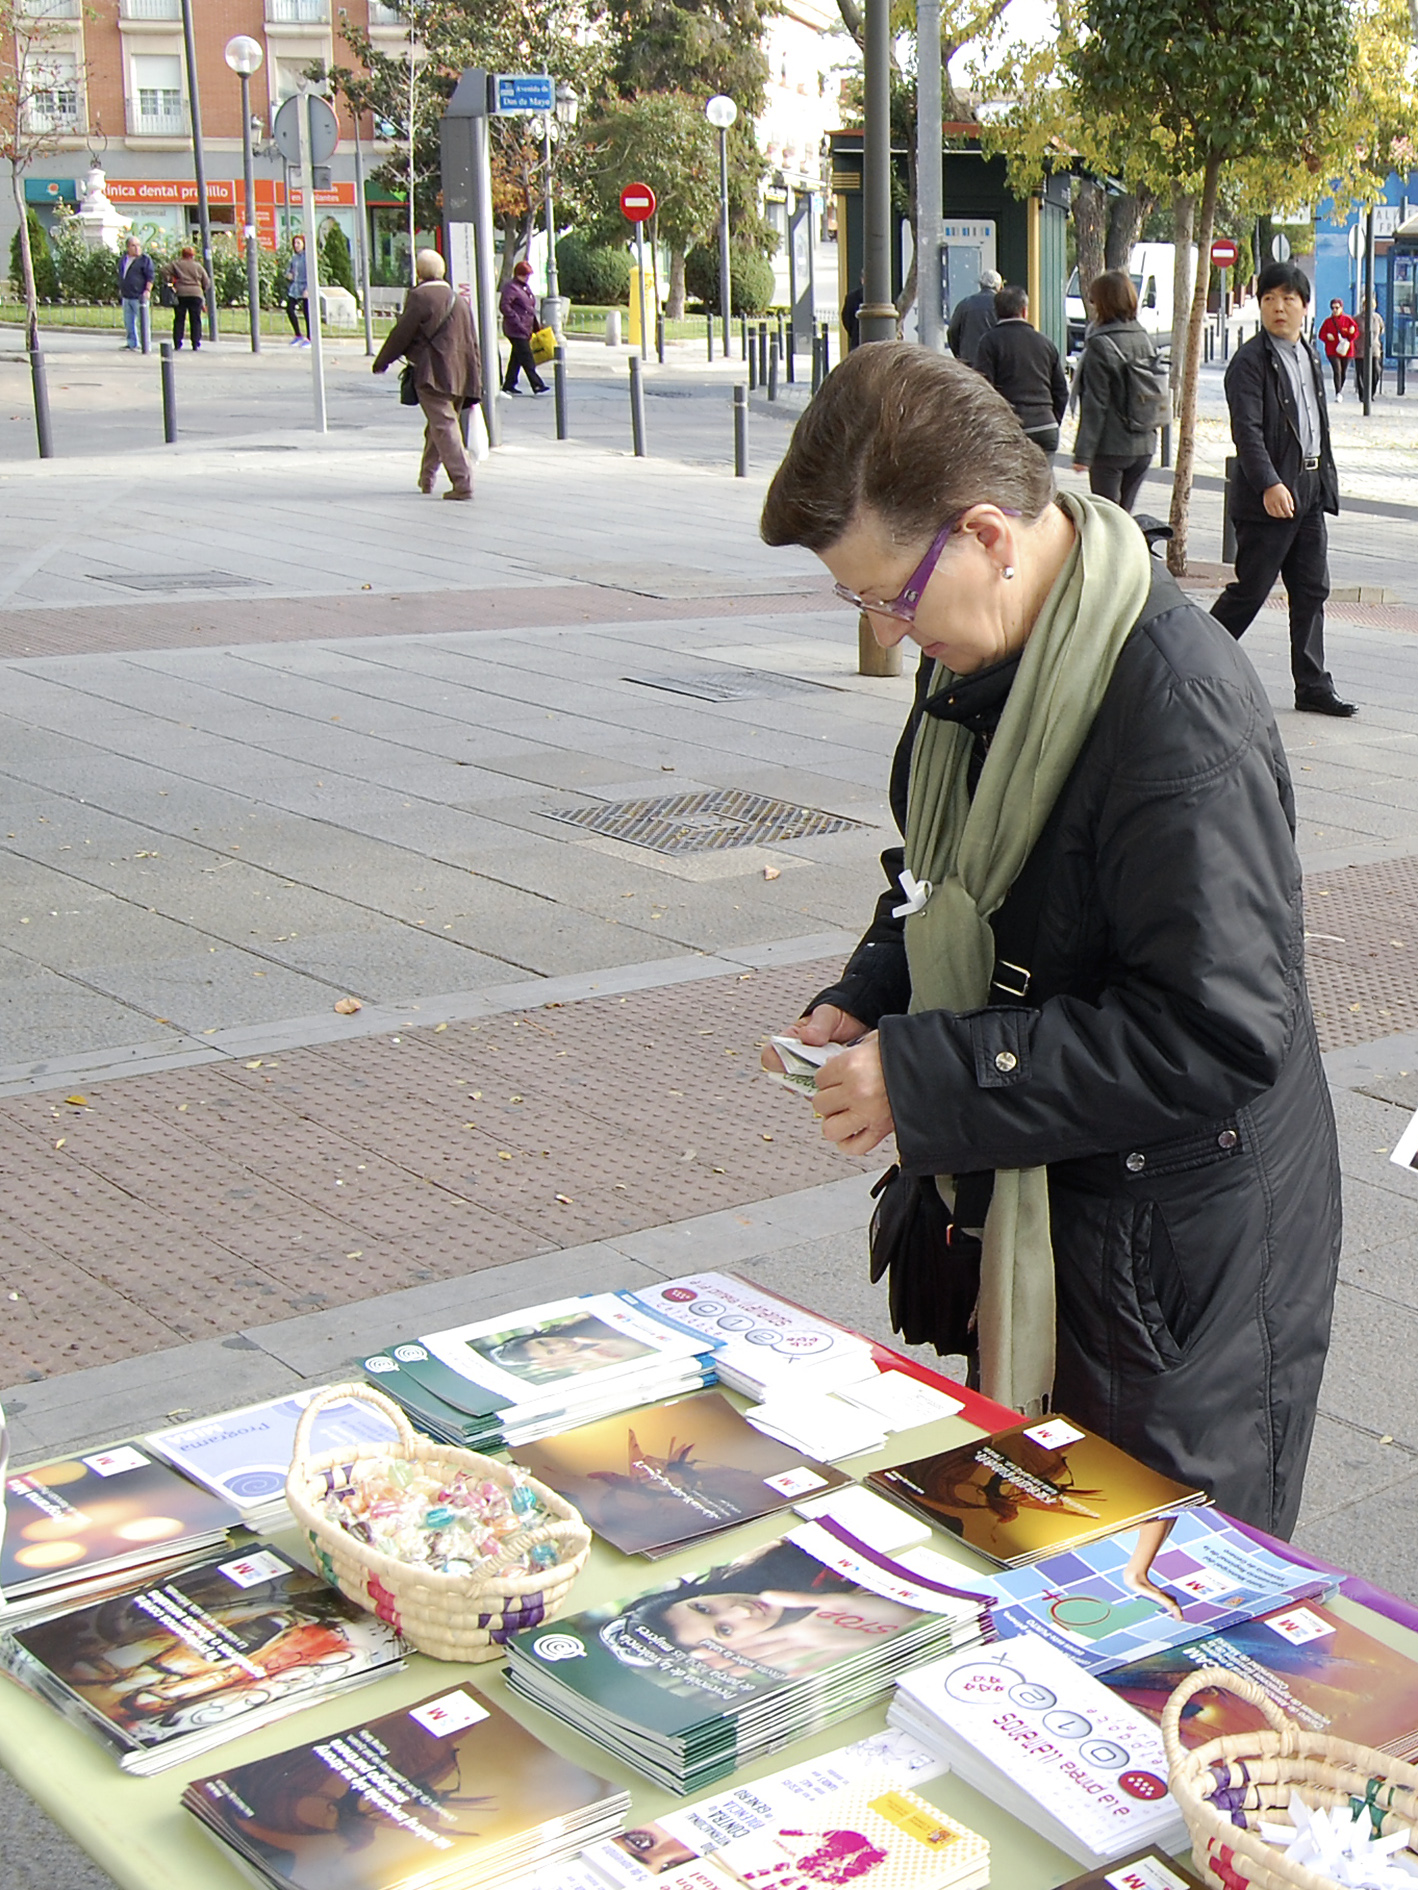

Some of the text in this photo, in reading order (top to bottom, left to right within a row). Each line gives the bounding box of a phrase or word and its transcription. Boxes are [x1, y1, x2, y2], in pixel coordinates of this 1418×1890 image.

[139, 183, 178, 197] dental
[164, 1423, 224, 1445] MIRA
[178, 1422, 268, 1451] Programa
[20, 1490, 71, 1523] Programa
[129, 1594, 168, 1617] contra
[142, 1588, 191, 1619] sexuales
[816, 1611, 899, 1634] STOP
[1025, 1618, 1052, 1638] PUNTO
[615, 1633, 664, 1665] violencia
[633, 1623, 675, 1652] mujeres
[699, 1636, 725, 1652] salud
[666, 1648, 687, 1662] las
[731, 1651, 757, 1667] sobre
[667, 1665, 686, 1677] de
[705, 1666, 742, 1687] pareja
[1247, 1659, 1289, 1690] Comunidad
[684, 1672, 737, 1700] Prevención
[736, 1681, 756, 1692] de
[1251, 1670, 1292, 1699] agresiones
[1257, 1684, 1290, 1708] Atención
[1296, 1710, 1324, 1729] Centro
[307, 1742, 356, 1771] strony
[322, 1737, 417, 1803] swojego partnera
[706, 1810, 750, 1839] CONTRA
